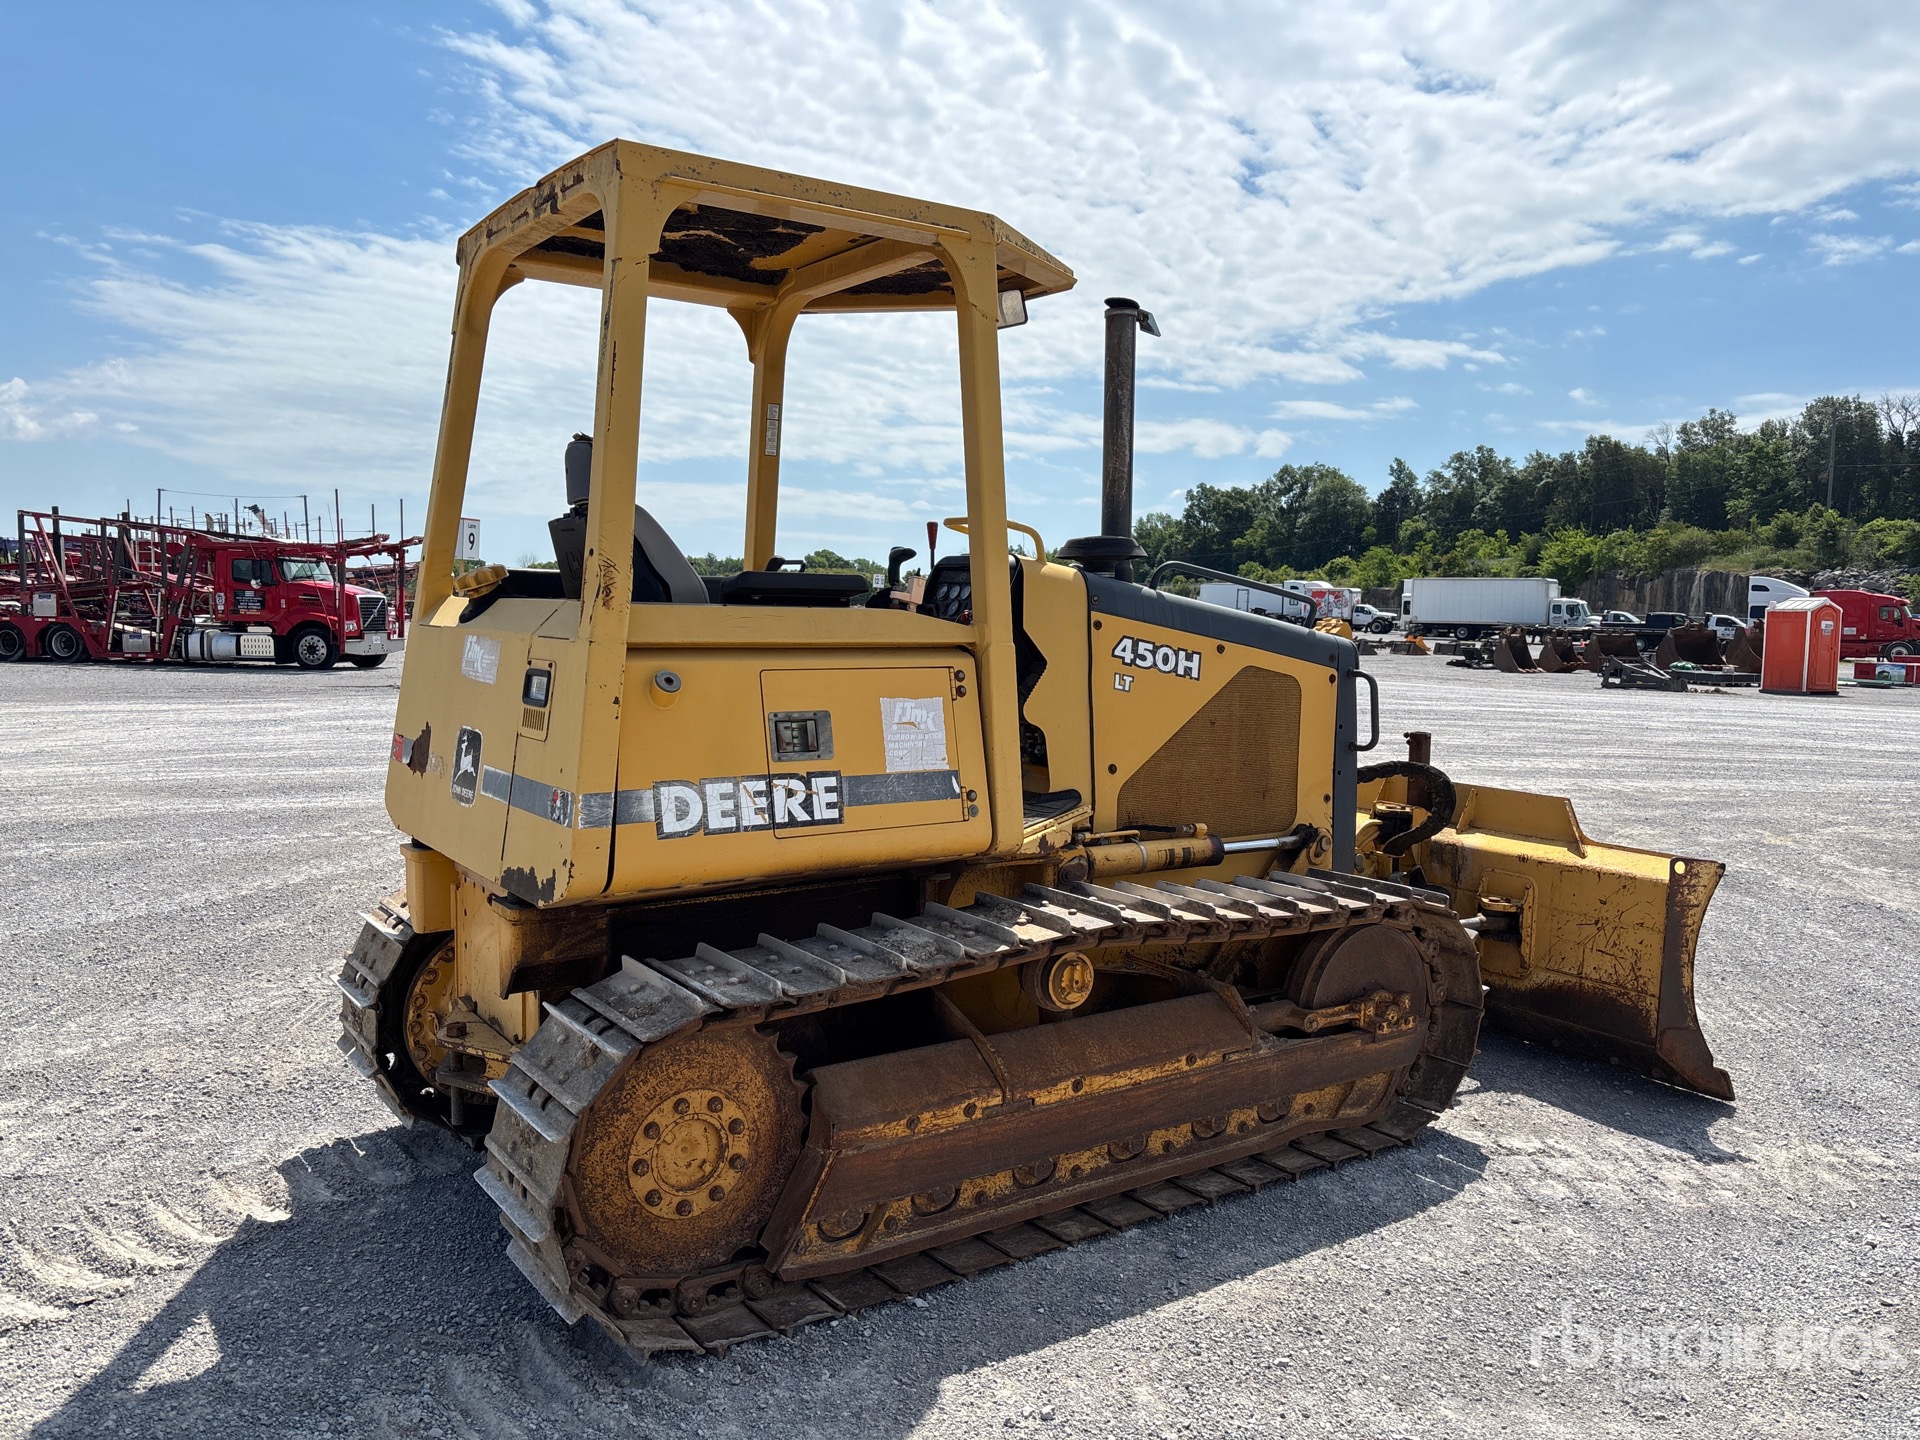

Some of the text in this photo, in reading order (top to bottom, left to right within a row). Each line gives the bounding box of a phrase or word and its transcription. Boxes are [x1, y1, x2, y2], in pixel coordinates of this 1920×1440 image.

[468, 532, 475, 550] 9
[1112, 635, 1201, 680] 450H
[1114, 673, 1133, 691] LT
[462, 787, 474, 799] DEERE
[660, 776, 840, 833] DEERE
